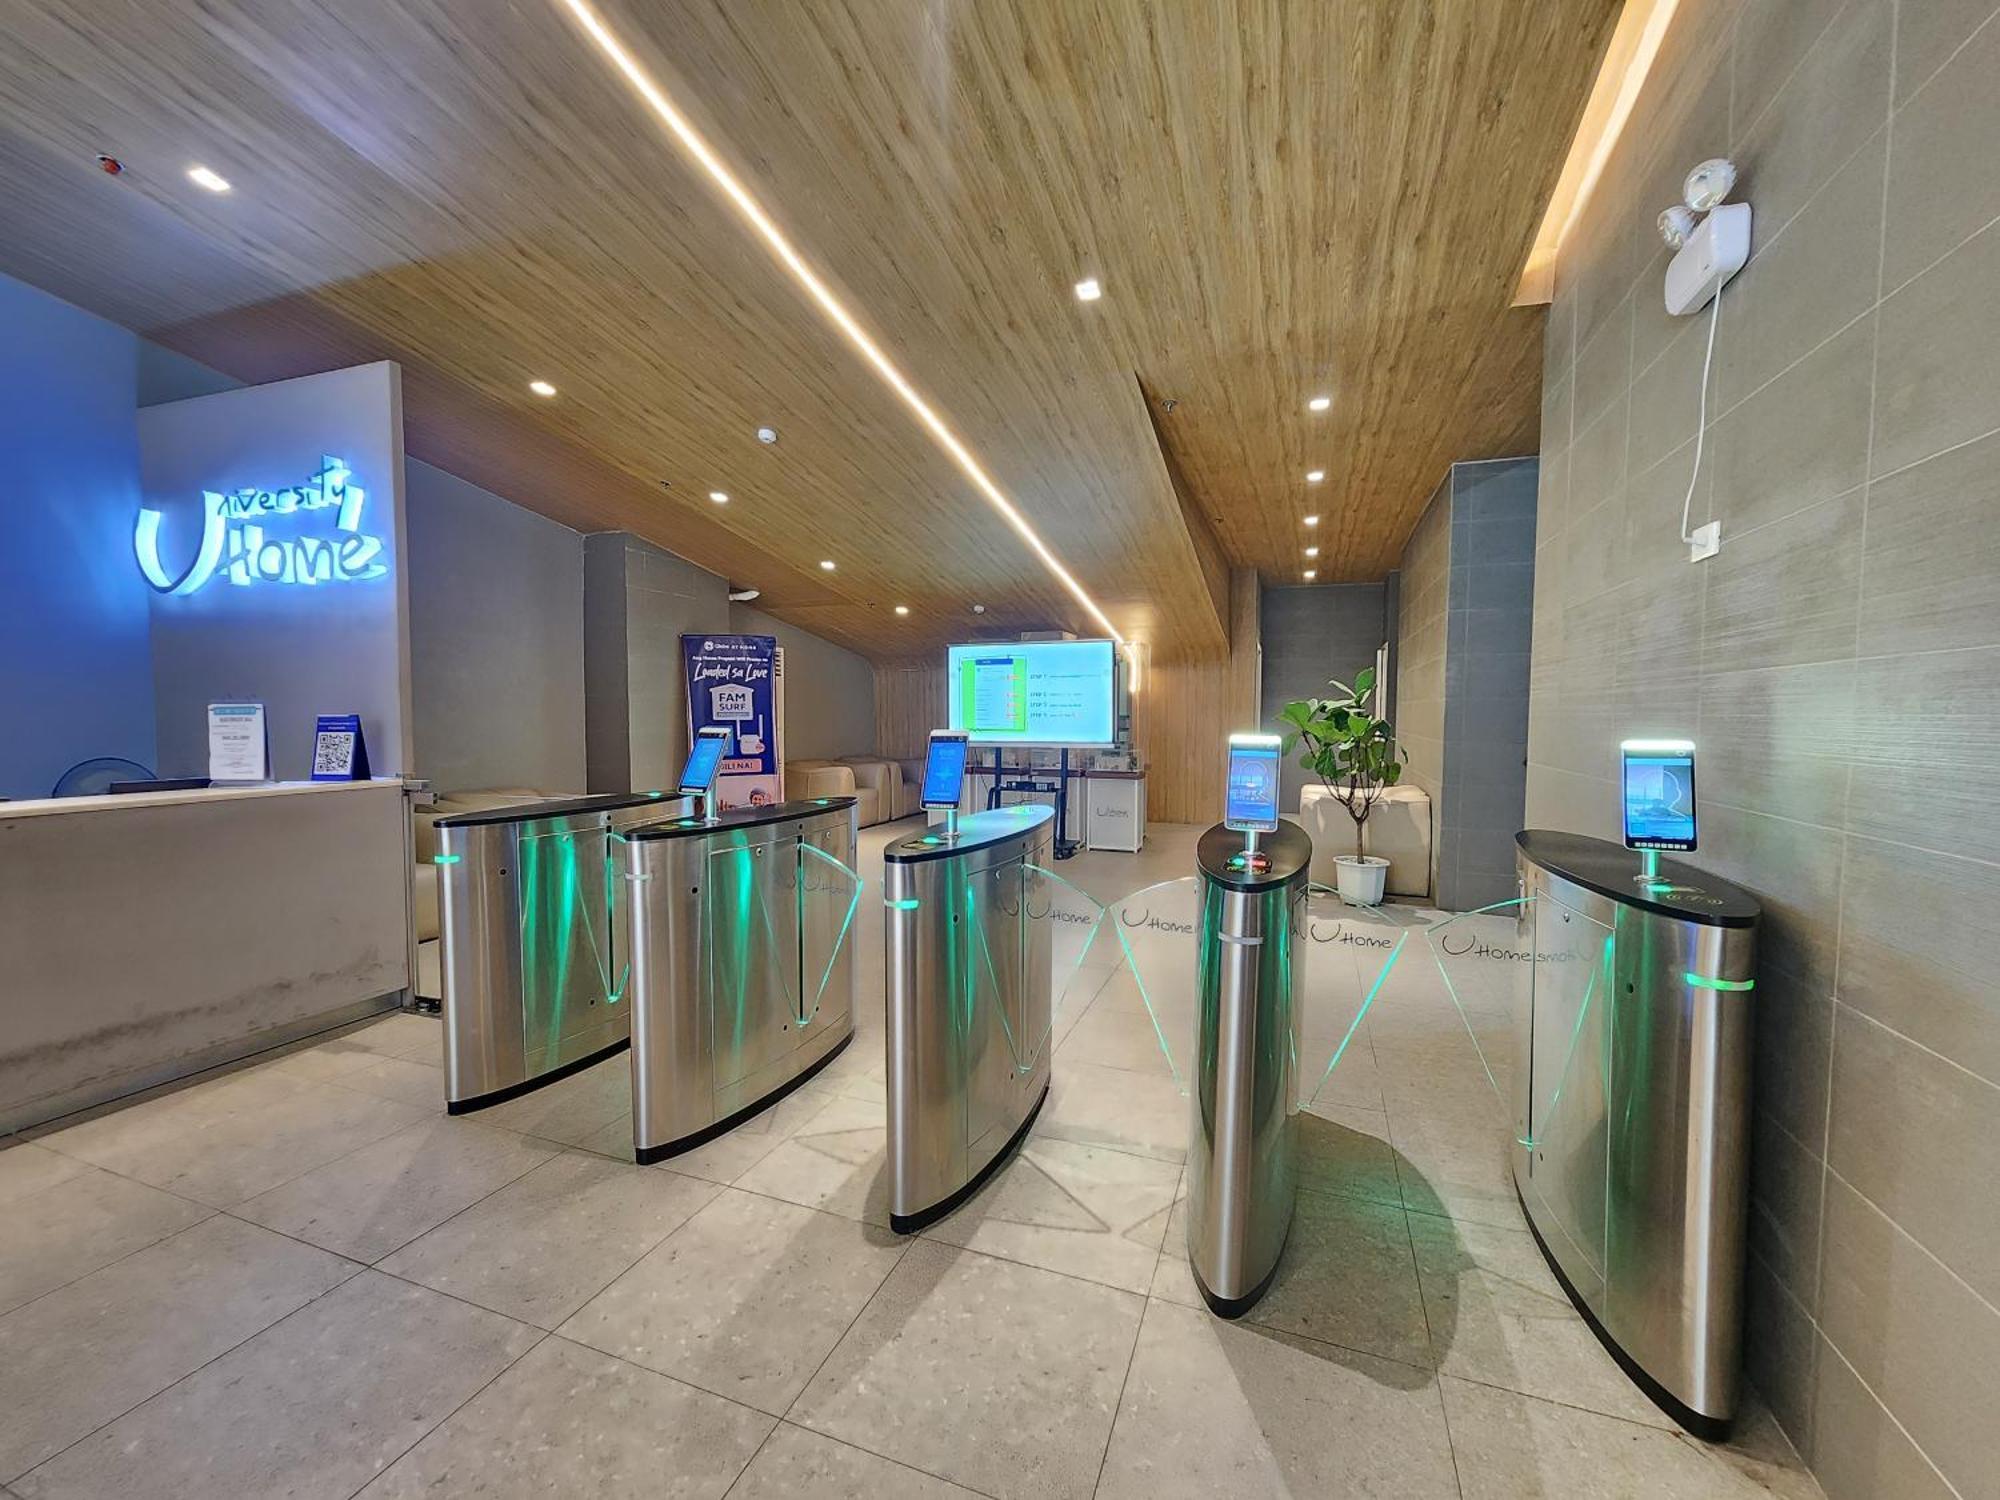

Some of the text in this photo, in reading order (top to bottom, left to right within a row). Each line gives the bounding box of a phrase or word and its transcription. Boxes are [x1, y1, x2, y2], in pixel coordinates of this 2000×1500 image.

[215, 524, 388, 587] Home
[693, 662, 768, 682] Loaded sa Love
[719, 693, 746, 702] FAM
[719, 703, 746, 712] SURF
[1049, 910, 1091, 925] Home
[1147, 917, 1194, 934] Home
[1339, 932, 1392, 949] Home
[1474, 944, 1532, 961] Home
